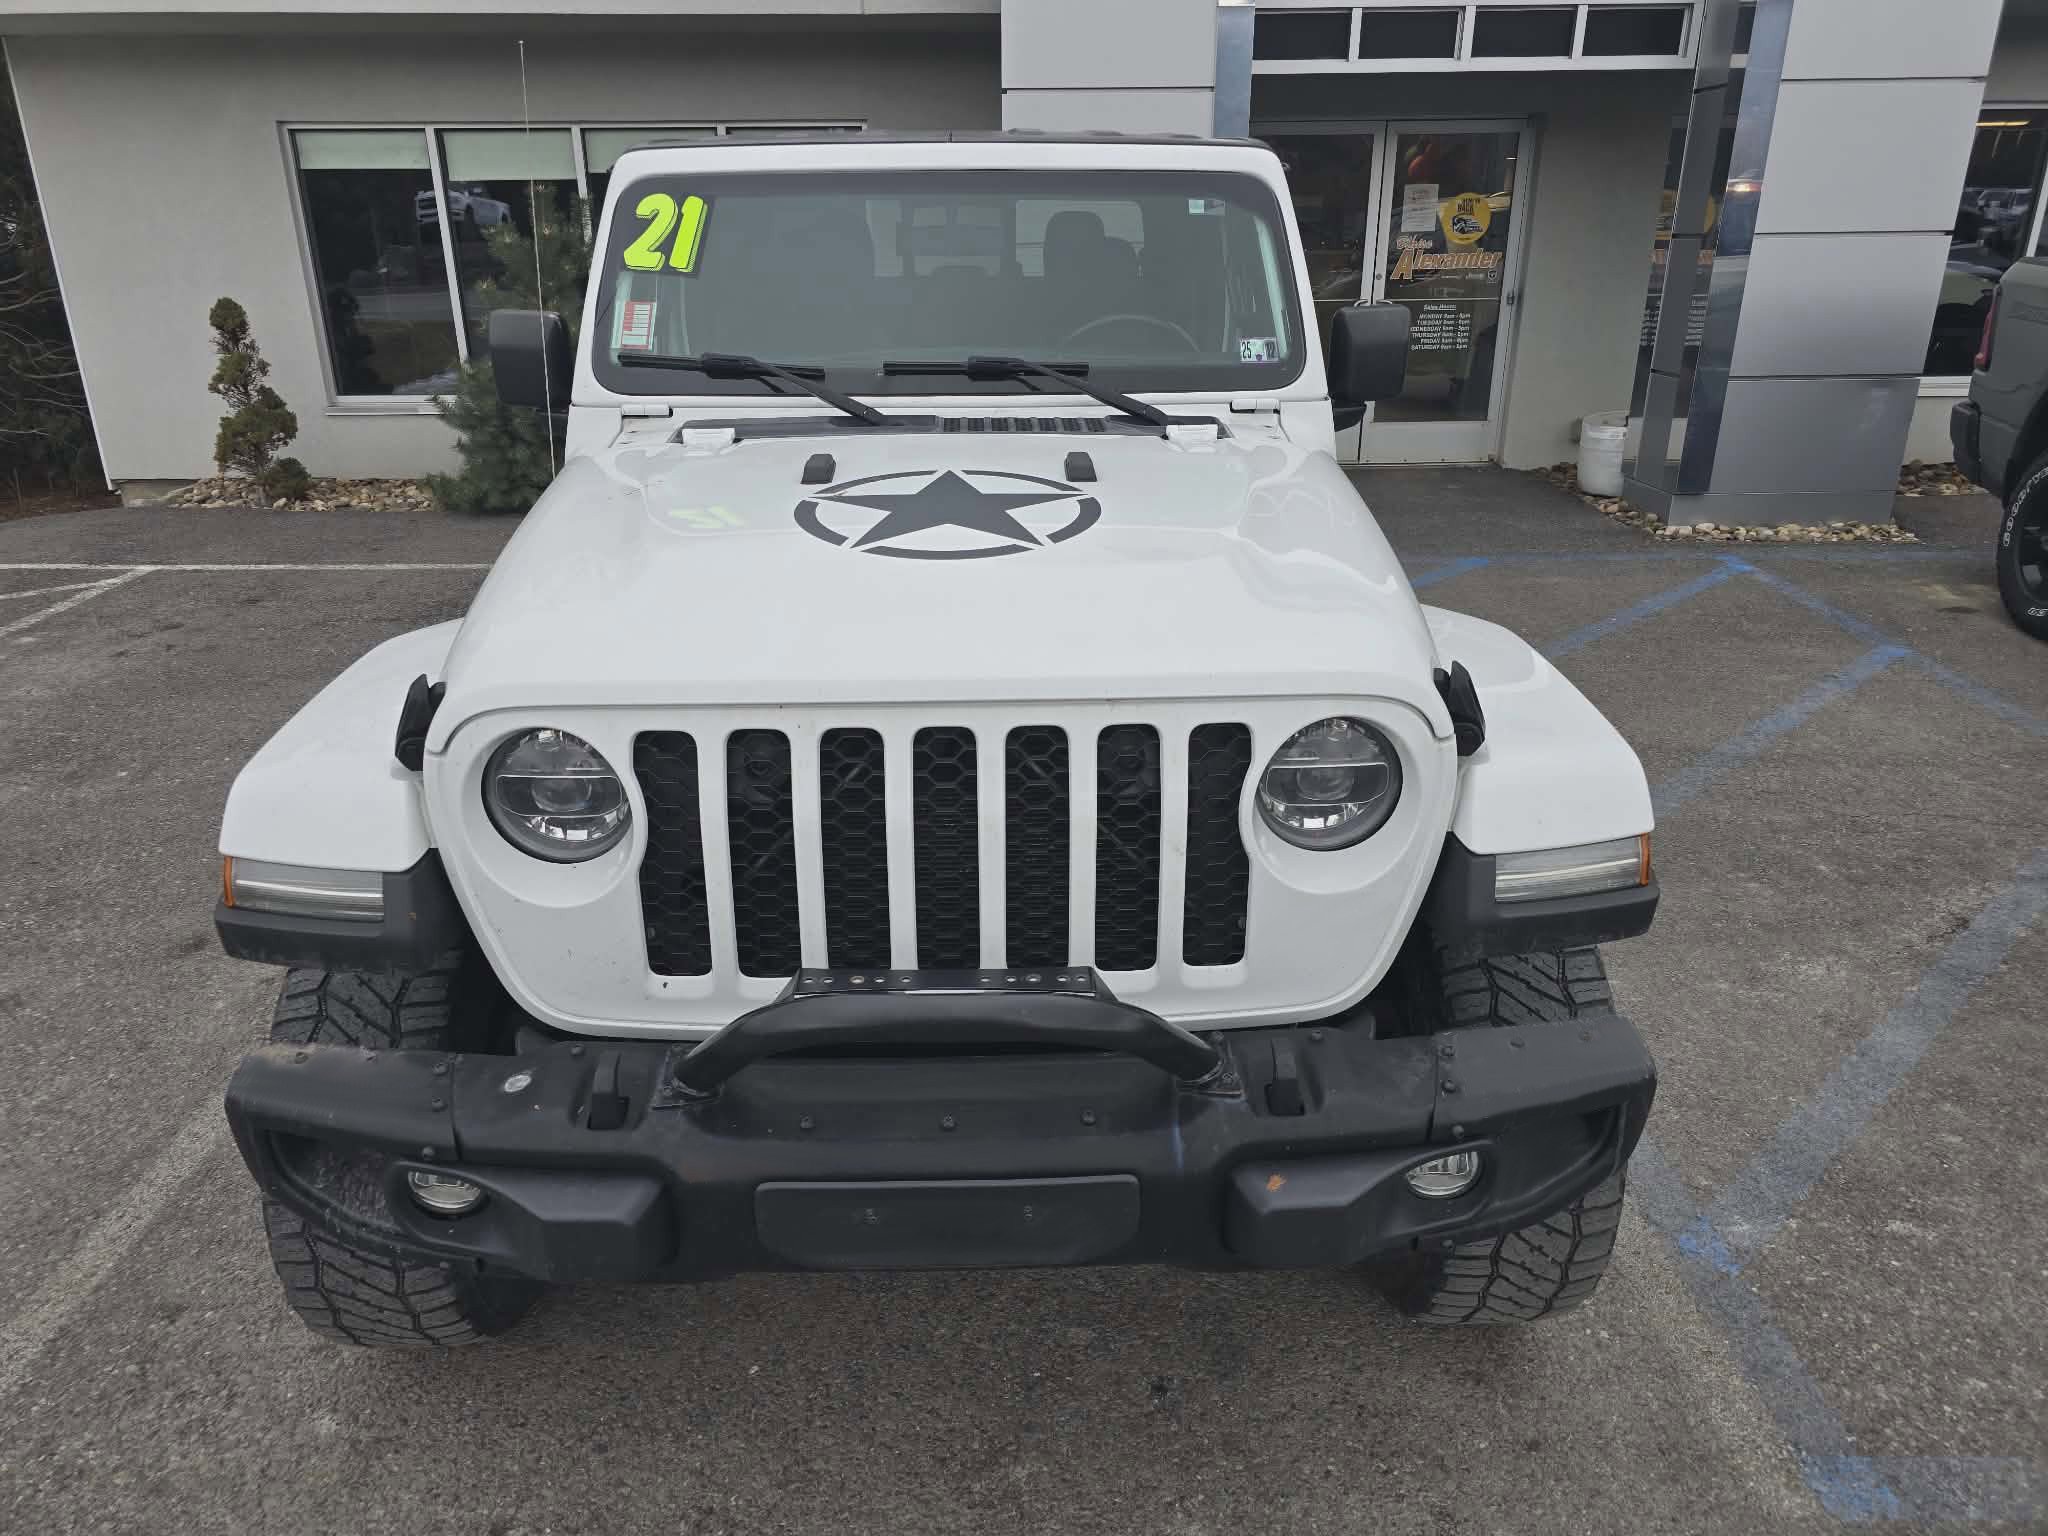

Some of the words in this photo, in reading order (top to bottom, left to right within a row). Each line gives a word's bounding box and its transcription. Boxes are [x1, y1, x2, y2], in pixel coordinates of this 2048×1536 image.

[624, 193, 708, 272] 21
[1390, 247, 1502, 280] Alexander
[1241, 341, 1252, 359] 25
